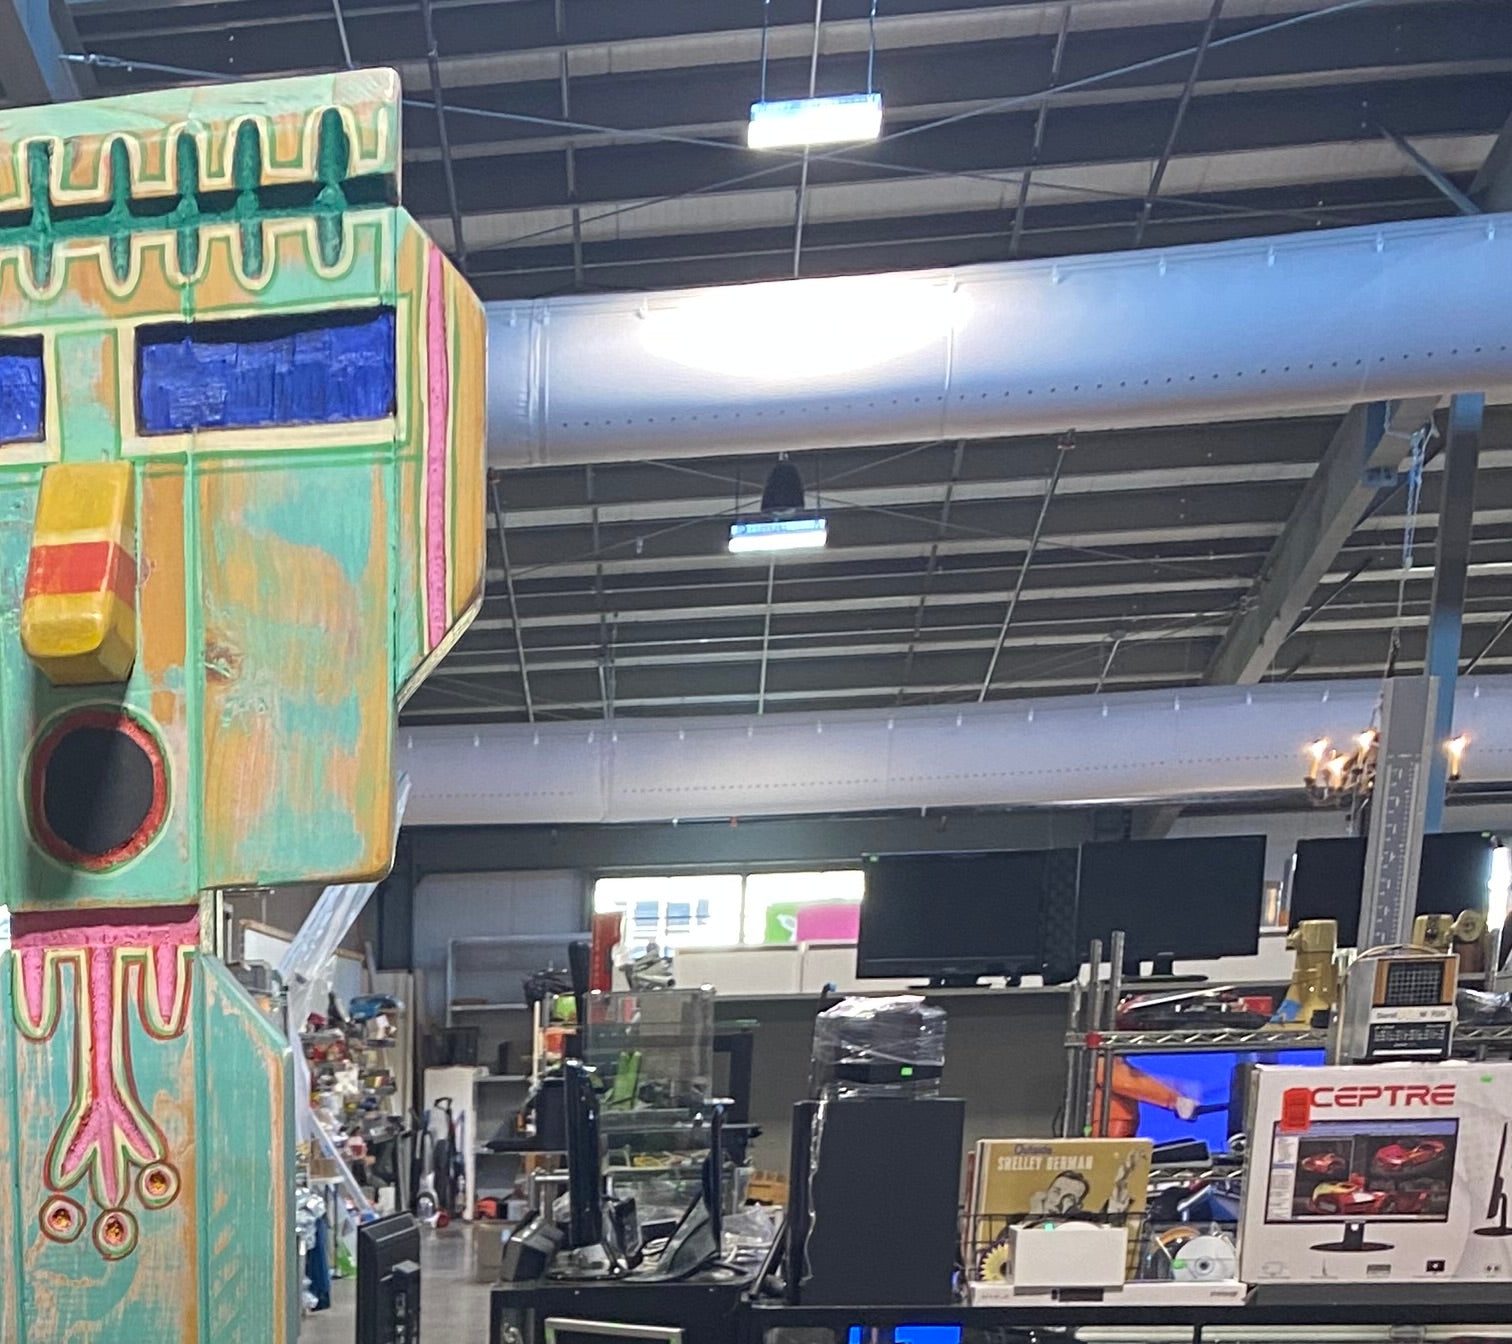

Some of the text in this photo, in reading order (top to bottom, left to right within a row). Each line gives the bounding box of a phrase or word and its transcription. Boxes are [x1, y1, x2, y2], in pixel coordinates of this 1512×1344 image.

[1310, 1084, 1456, 1107] CEPTRE
[997, 1156, 1094, 1171] SHELLEY BERMAN
